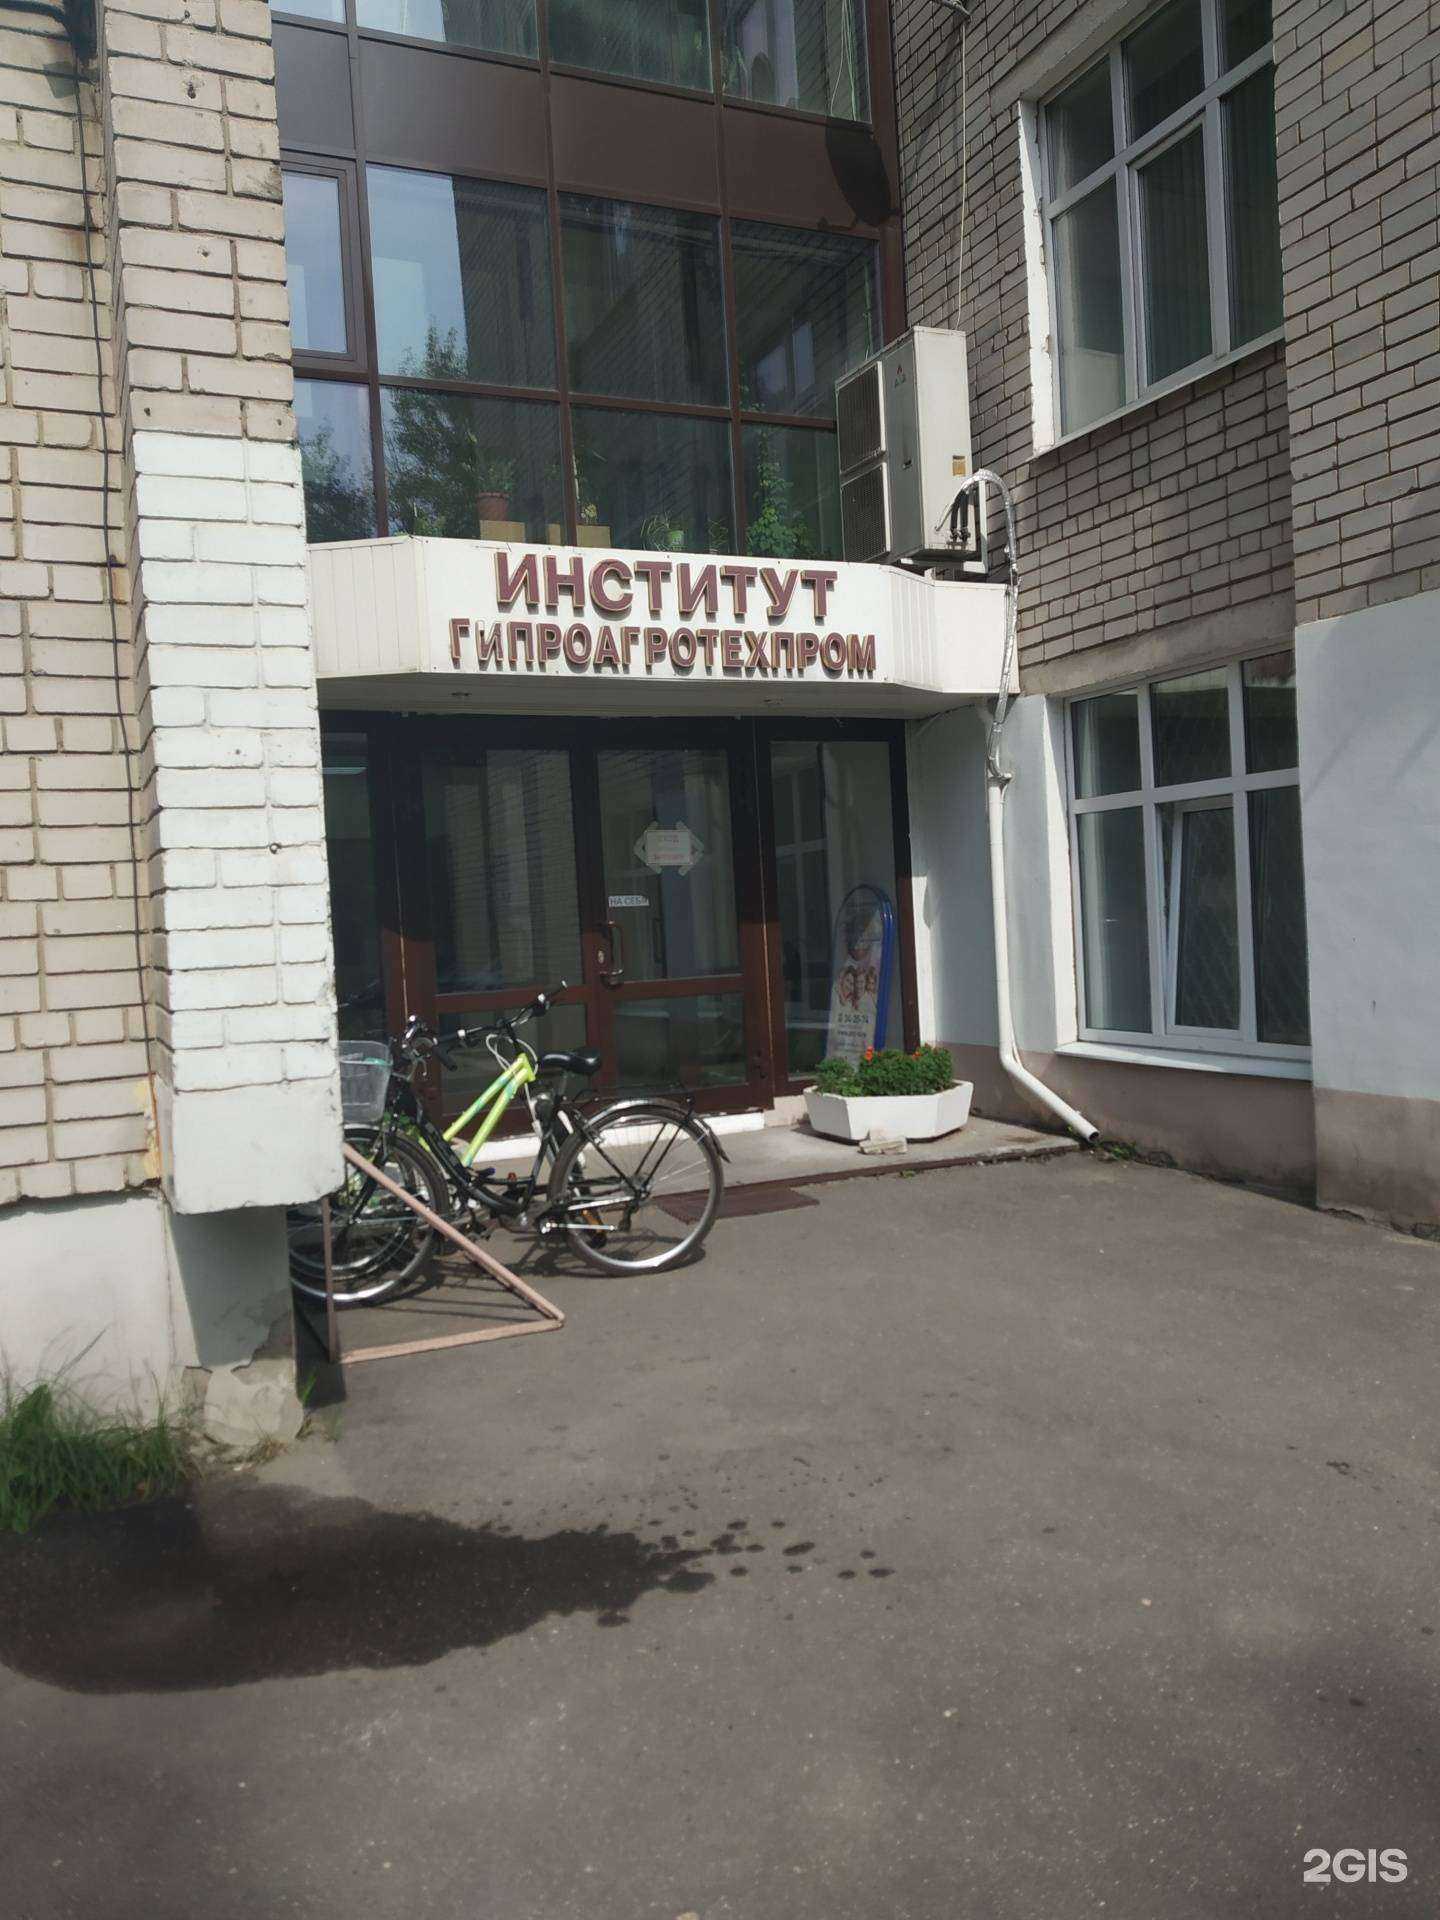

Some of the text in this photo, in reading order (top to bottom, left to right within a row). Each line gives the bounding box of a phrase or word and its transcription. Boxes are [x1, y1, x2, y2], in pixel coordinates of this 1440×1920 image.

[495, 552, 838, 617] ИНСТИТУТ
[450, 618, 876, 671] ГИПРОАГРОТЕХПРОМ
[608, 896, 623, 906] НА
